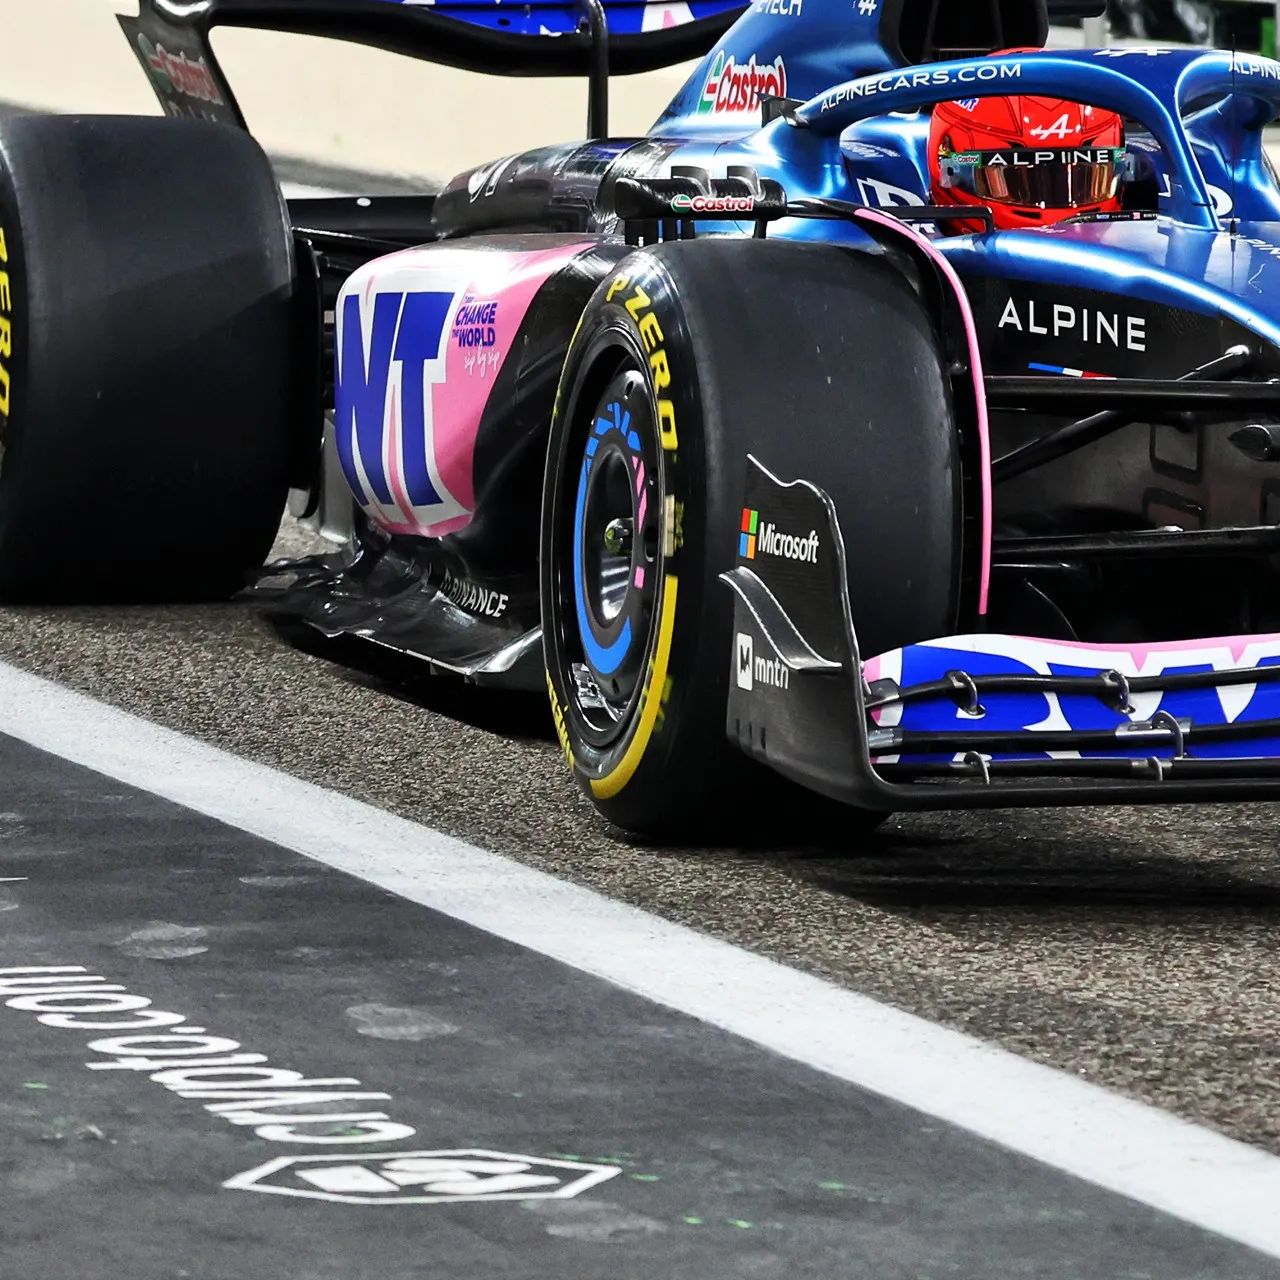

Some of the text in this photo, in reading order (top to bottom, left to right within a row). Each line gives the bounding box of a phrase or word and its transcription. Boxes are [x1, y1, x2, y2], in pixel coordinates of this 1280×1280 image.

[714, 54, 787, 114] Castrol
[820, 63, 1021, 113] ALPINECARS.COM
[987, 149, 1110, 166] ALPINE
[691, 195, 755, 212] Castrol
[455, 302, 498, 326] CHANGE
[997, 296, 1146, 352] ALPINE
[458, 327, 496, 347] WORLD
[624, 286, 679, 451] ZERO
[757, 521, 820, 564] Microsoft
[448, 578, 509, 618] BINANCE
